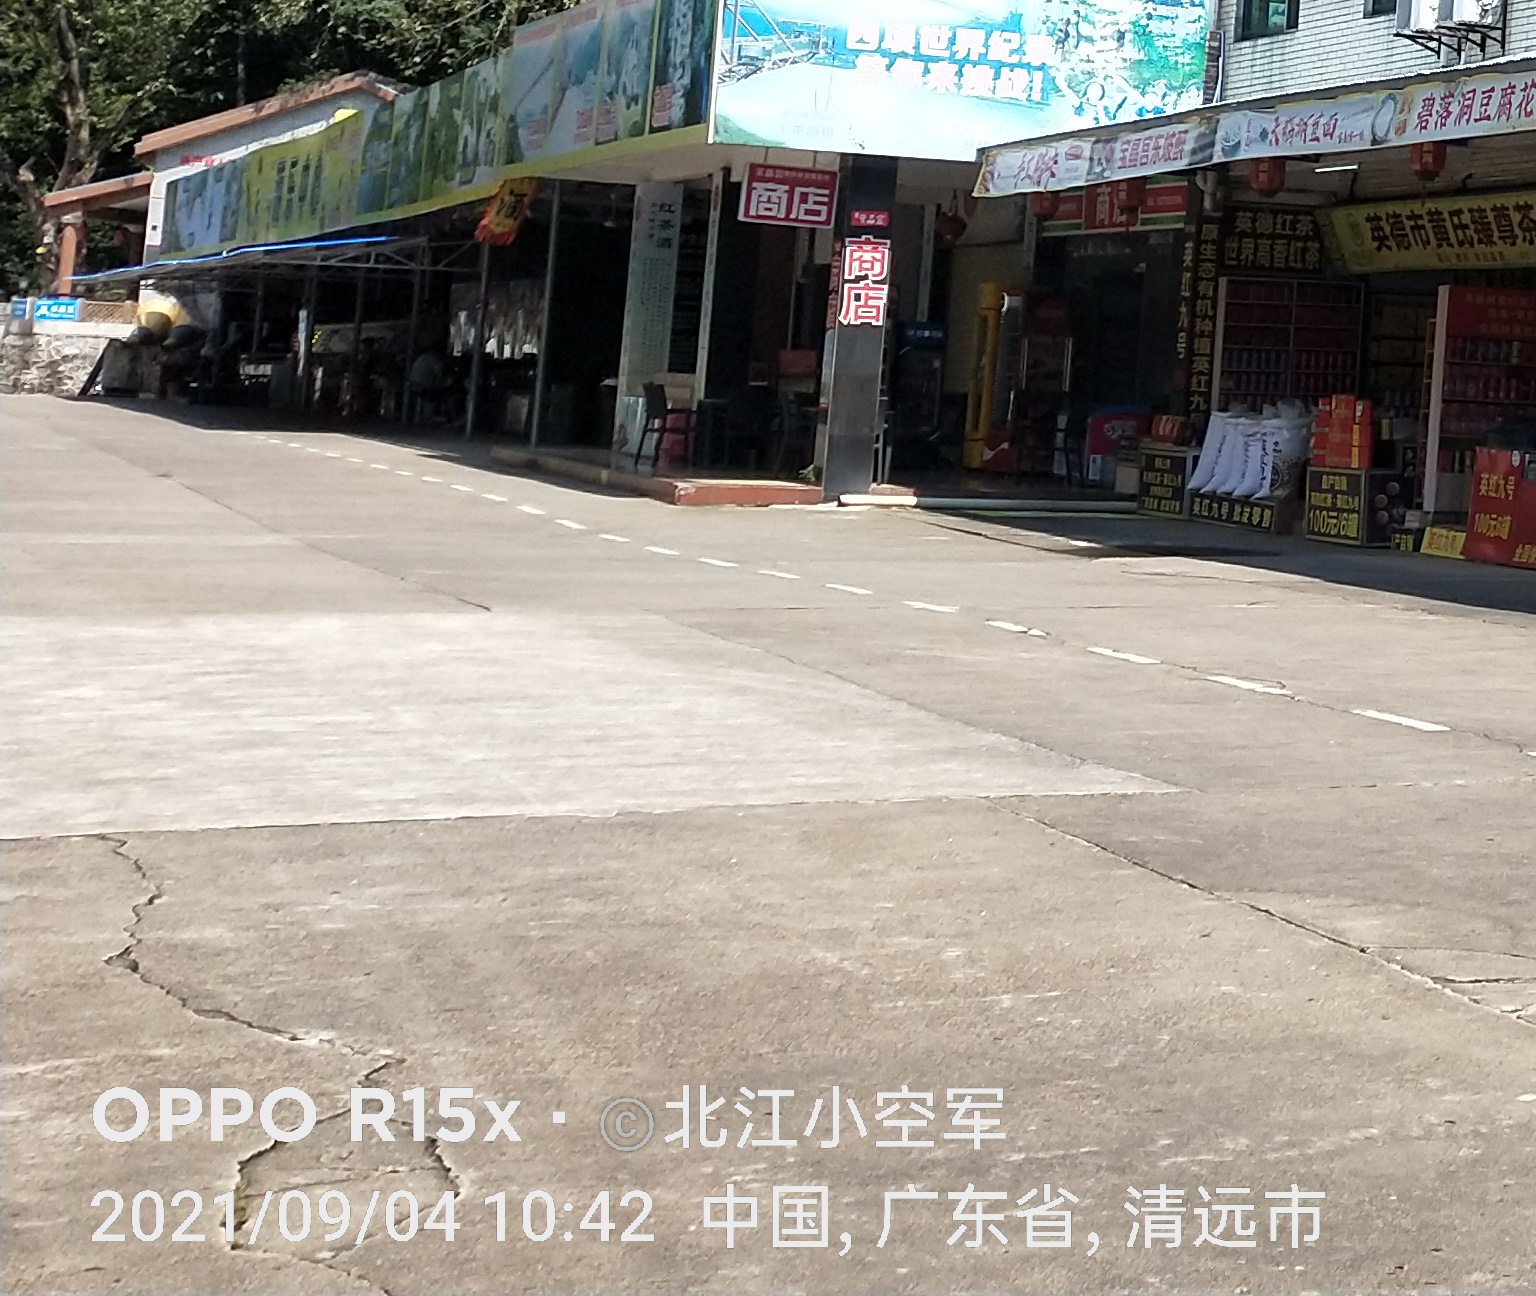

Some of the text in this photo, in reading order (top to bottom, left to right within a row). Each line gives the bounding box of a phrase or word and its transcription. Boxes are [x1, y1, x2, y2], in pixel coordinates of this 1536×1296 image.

[748, 181, 831, 223] 商店
[1234, 210, 1317, 237] 英德红茶
[1224, 235, 1321, 271] 世界高香红茶
[837, 233, 893, 327] 商店
